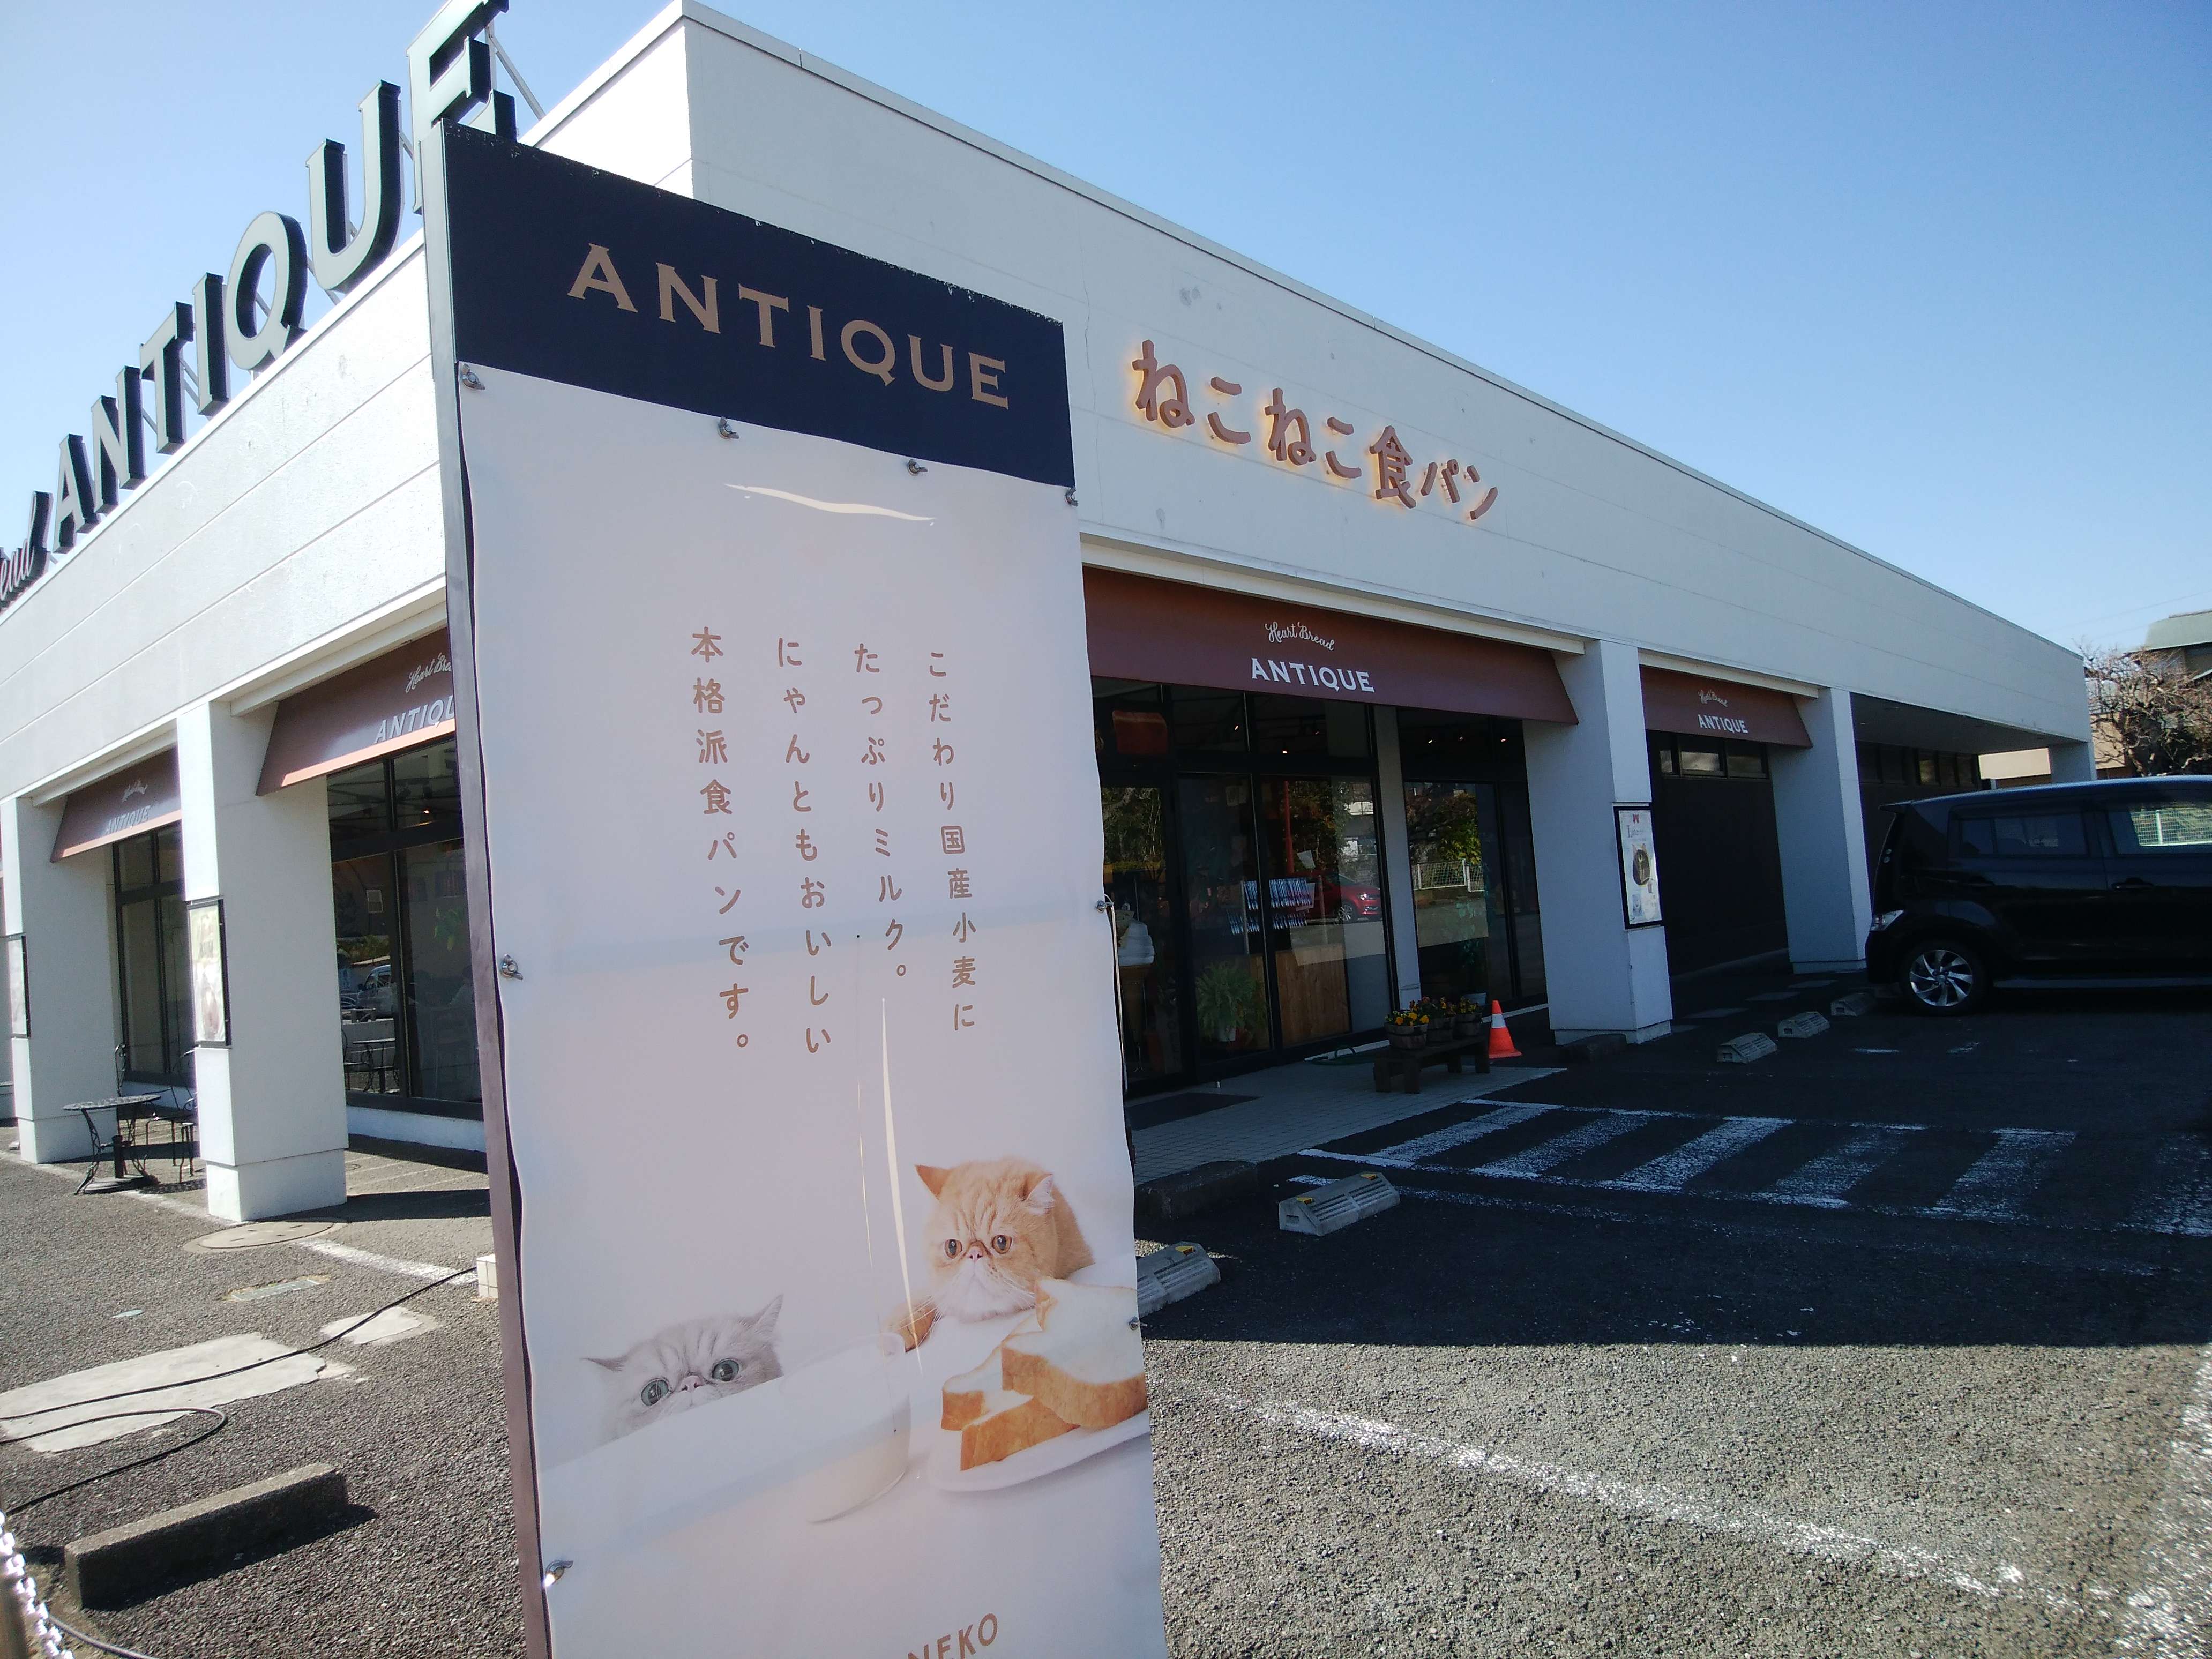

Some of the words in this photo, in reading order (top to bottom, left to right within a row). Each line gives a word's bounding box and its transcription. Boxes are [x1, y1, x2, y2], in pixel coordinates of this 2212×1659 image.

[53, 0, 515, 554] ANTIQUE
[567, 243, 1008, 410] ANTIQUE
[1132, 339, 1498, 520] ねこねこ食パン
[1251, 658, 1375, 692] ANTIQUE
[1265, 621, 1298, 643] Heart
[1297, 622, 1334, 651] Bread
[1698, 714, 1748, 734] ANTIQUE
[691, 626, 749, 1048] 本格派食パンです。
[778, 638, 831, 1053] にゃんともおいしい
[855, 643, 907, 977] たっぷりミルク。
[929, 652, 976, 1031] こだわり国産小麦に
